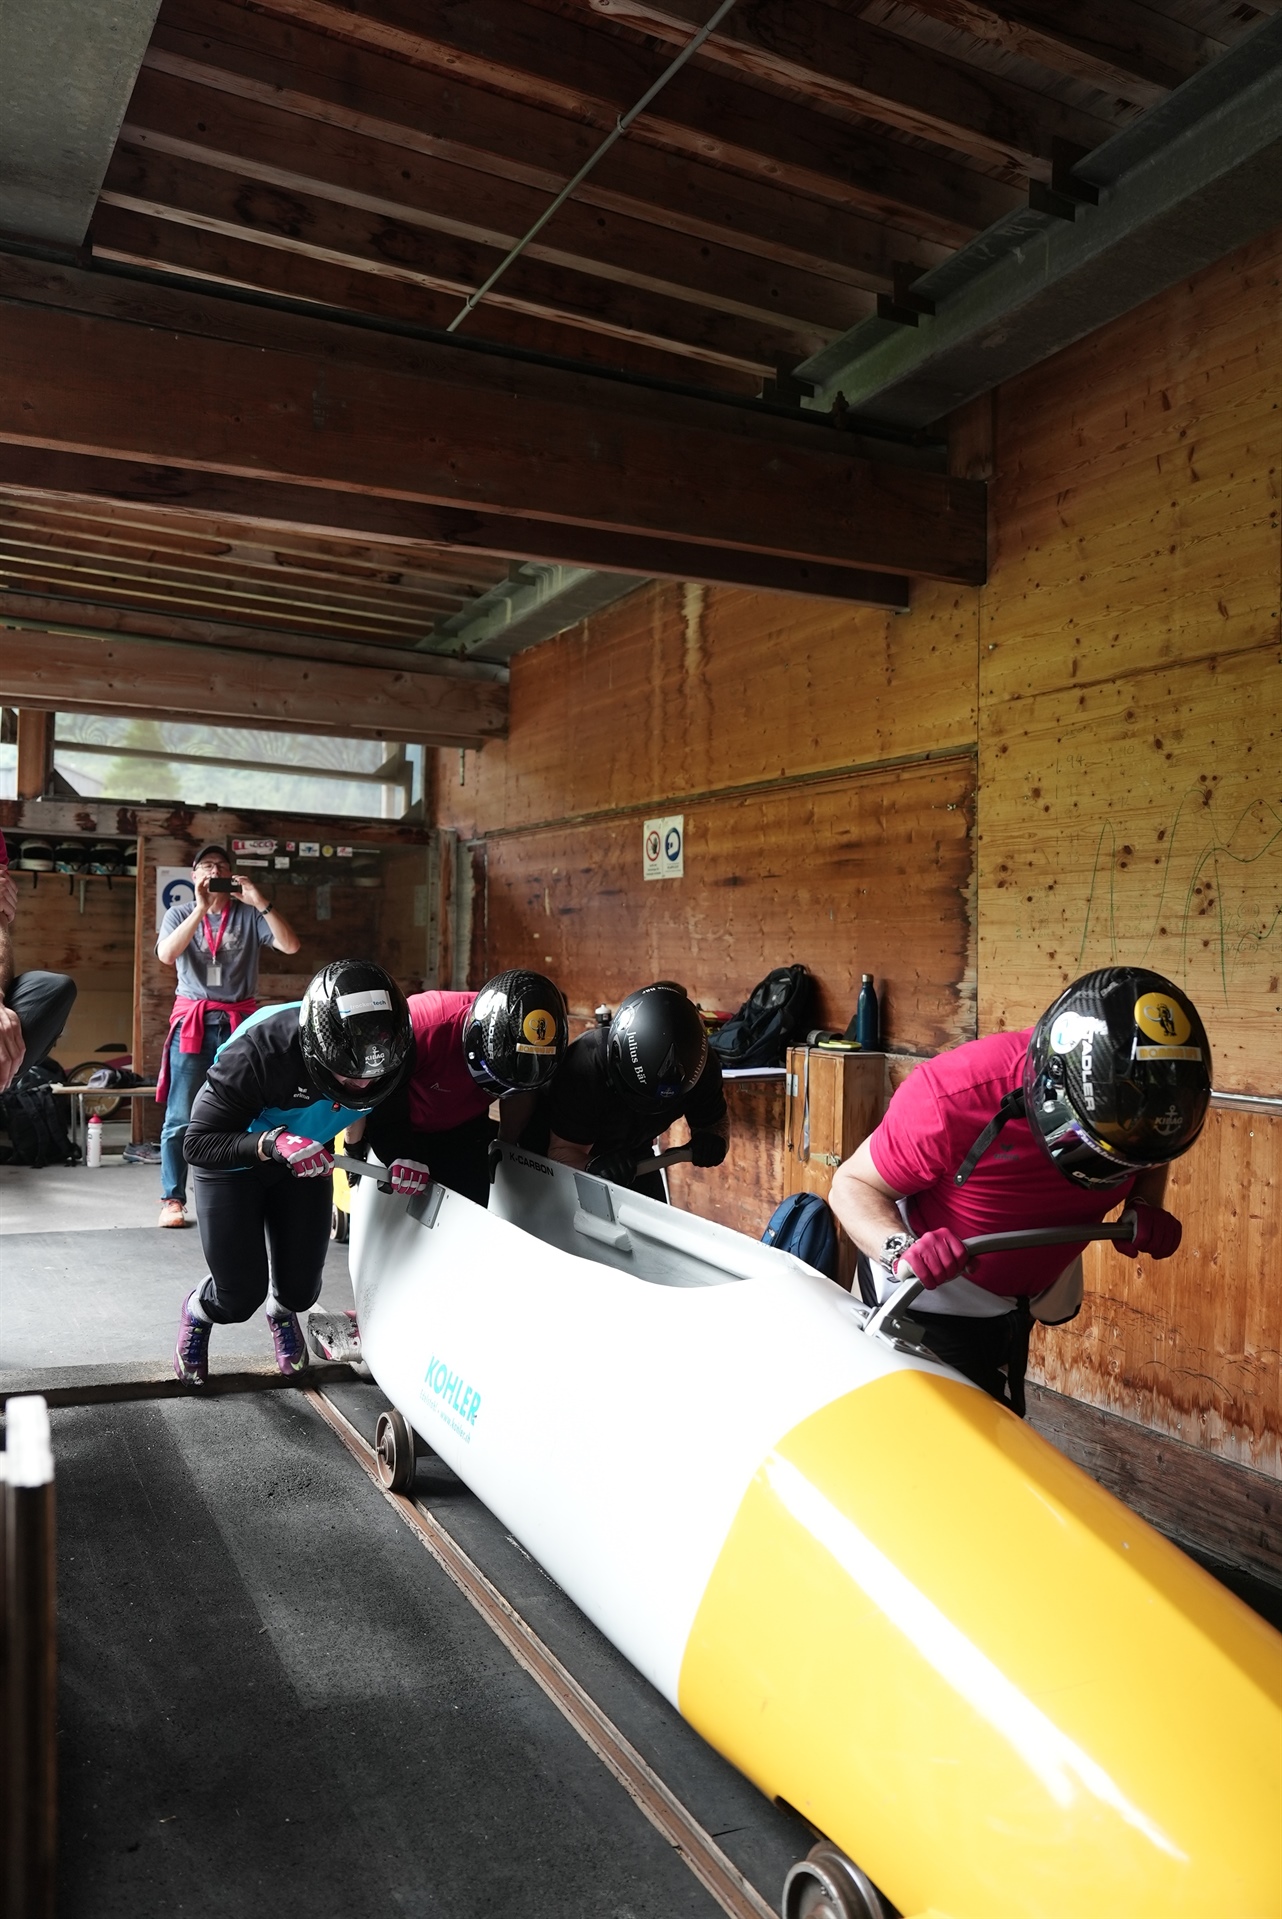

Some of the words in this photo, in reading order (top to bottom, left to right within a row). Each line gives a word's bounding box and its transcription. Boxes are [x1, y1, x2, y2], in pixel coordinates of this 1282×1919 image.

[487, 1005, 500, 1060] TADLER
[626, 1031, 639, 1064] Julius
[634, 1066, 648, 1085] Bär
[1079, 1024, 1096, 1112] TADLER
[424, 1355, 482, 1426] KOHLER
